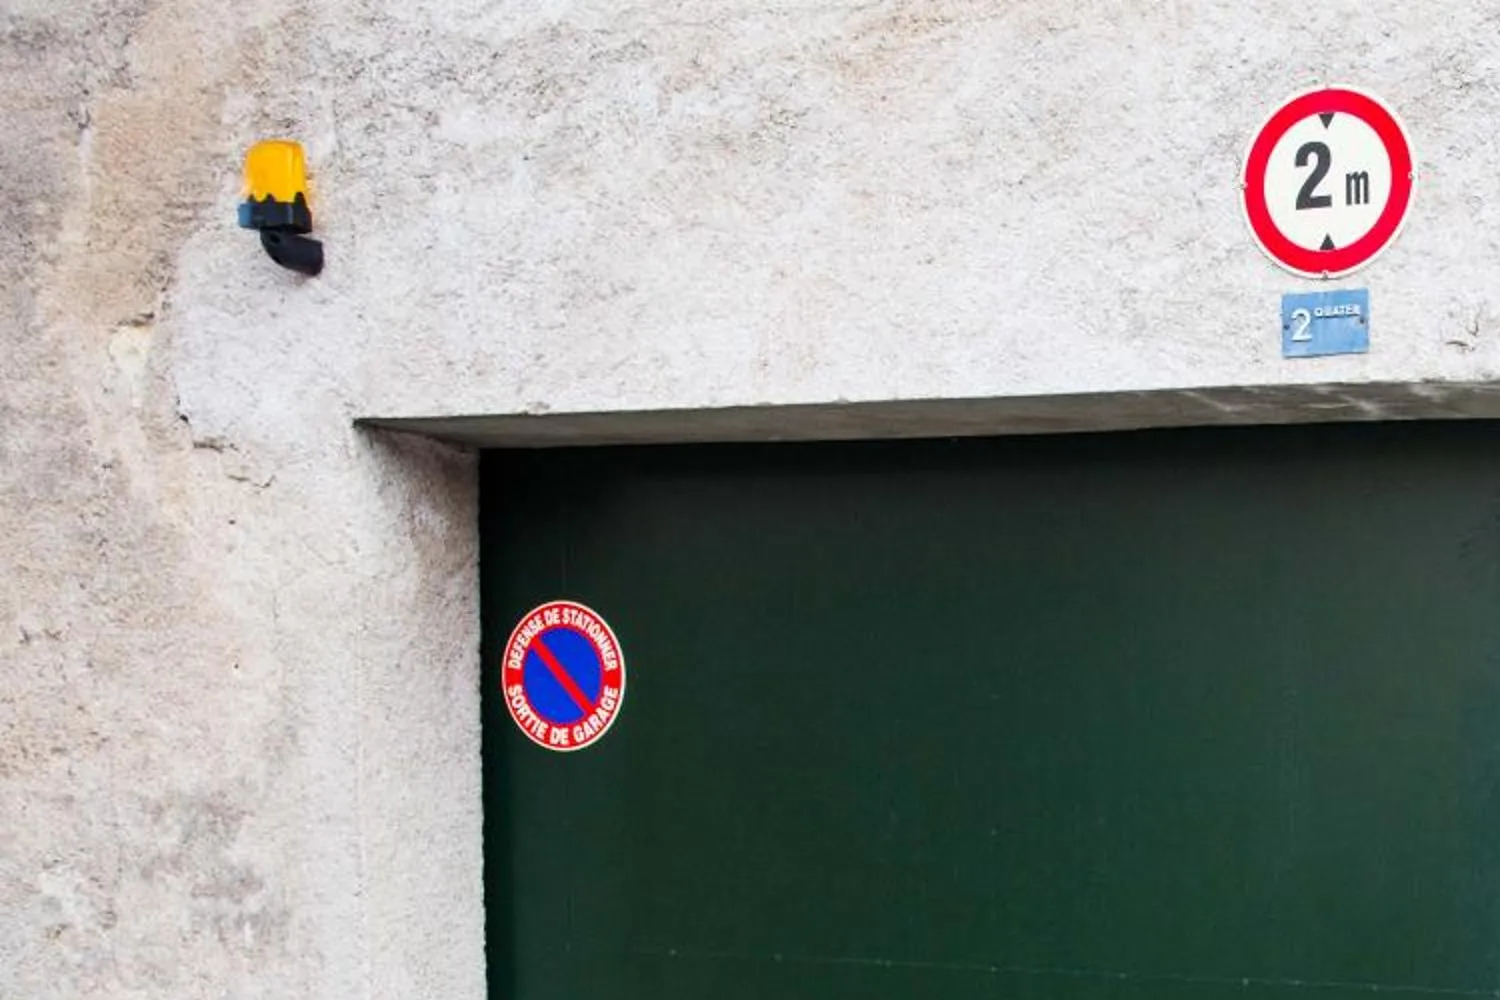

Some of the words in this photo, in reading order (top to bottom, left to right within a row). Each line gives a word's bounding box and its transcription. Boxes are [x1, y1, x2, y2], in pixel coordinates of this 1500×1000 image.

[1294, 141, 1332, 210] 2
[1345, 170, 1370, 205] m
[1291, 308, 1313, 341] 2
[508, 614, 545, 670] DEFENSE
[544, 608, 562, 626] DE
[562, 607, 618, 671] STATIONNER
[508, 684, 549, 740] SORTIE
[550, 727, 570, 745] DE
[572, 685, 618, 744] GARAGE
